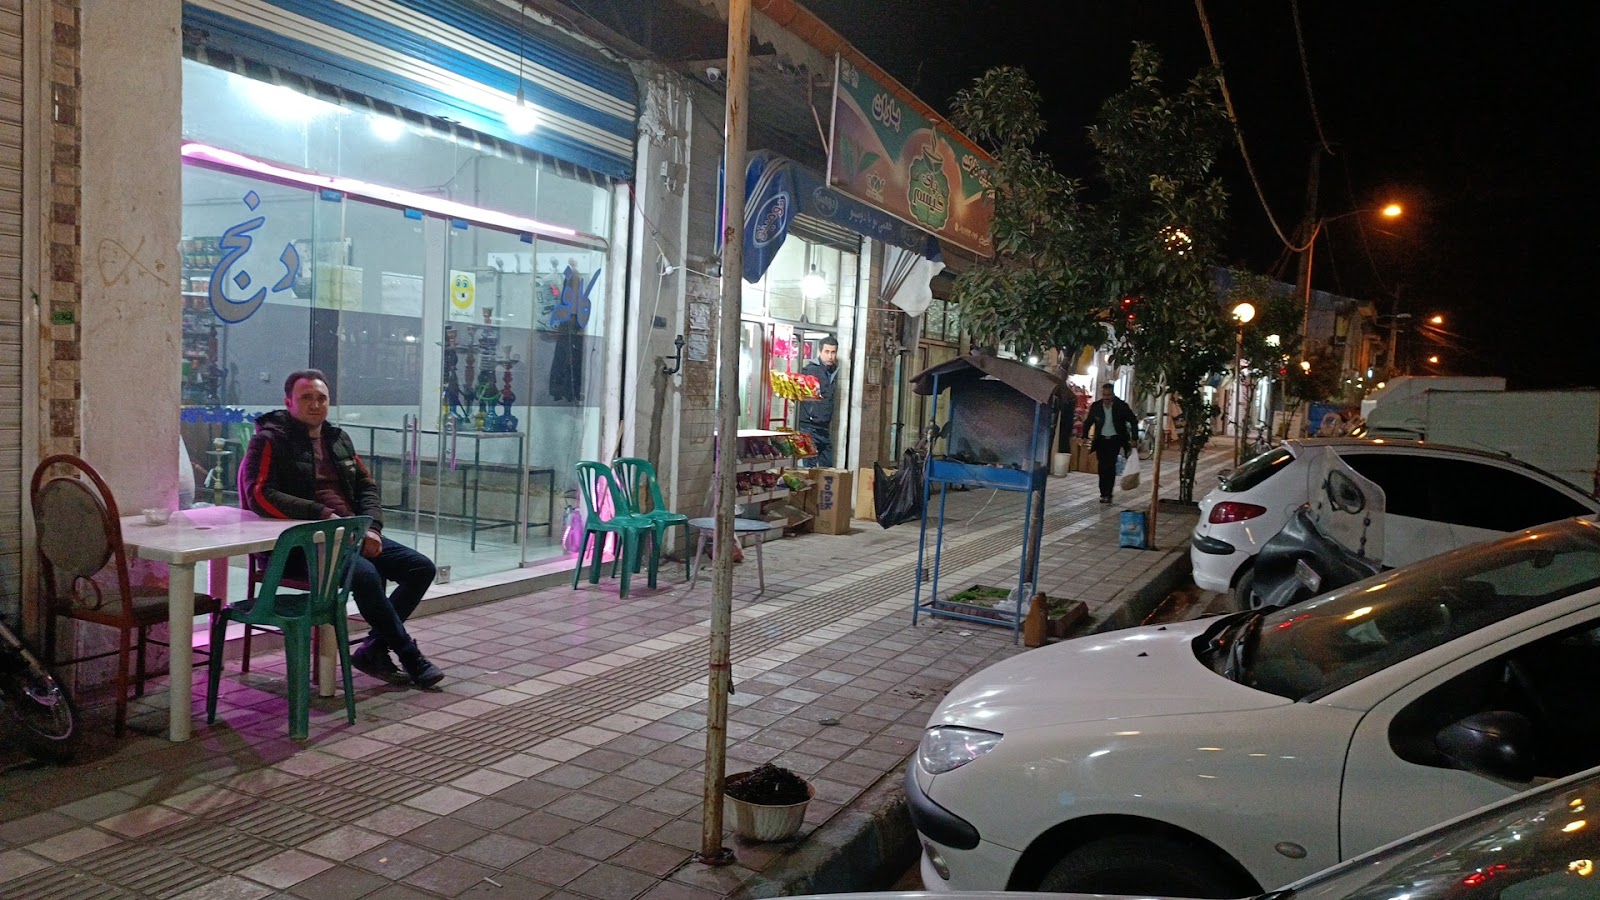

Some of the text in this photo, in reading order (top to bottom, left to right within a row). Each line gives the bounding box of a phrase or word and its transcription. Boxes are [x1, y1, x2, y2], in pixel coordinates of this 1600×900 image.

[872, 93, 902, 133] باران
[208, 190, 602, 329] کافه دنج
[824, 476, 833, 510] Pofak
